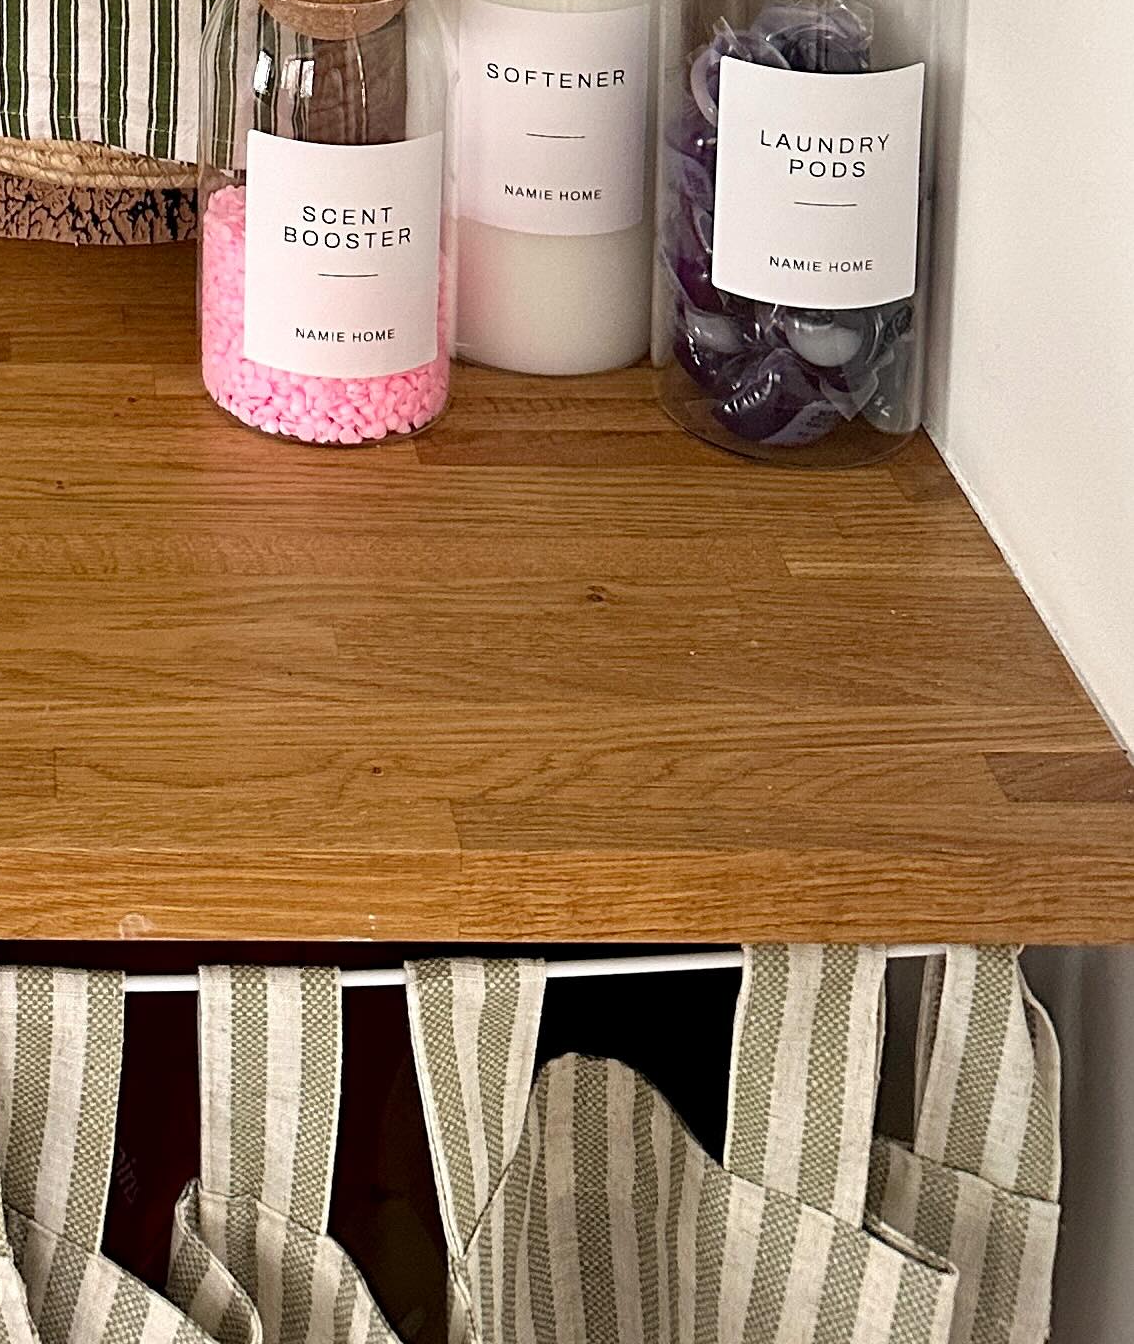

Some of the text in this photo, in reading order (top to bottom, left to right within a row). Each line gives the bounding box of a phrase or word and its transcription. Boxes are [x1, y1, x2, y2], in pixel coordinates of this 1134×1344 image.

[485, 62, 627, 90] SOFTENER
[759, 129, 890, 155] LAUNDRY
[788, 158, 867, 179] PODS
[504, 183, 603, 202] NAMIE HOME
[302, 205, 394, 226] SCENT
[283, 226, 412, 250] BOOSTER
[769, 255, 874, 273] NAMIE HOME
[295, 327, 397, 343] NAMIE HOME
